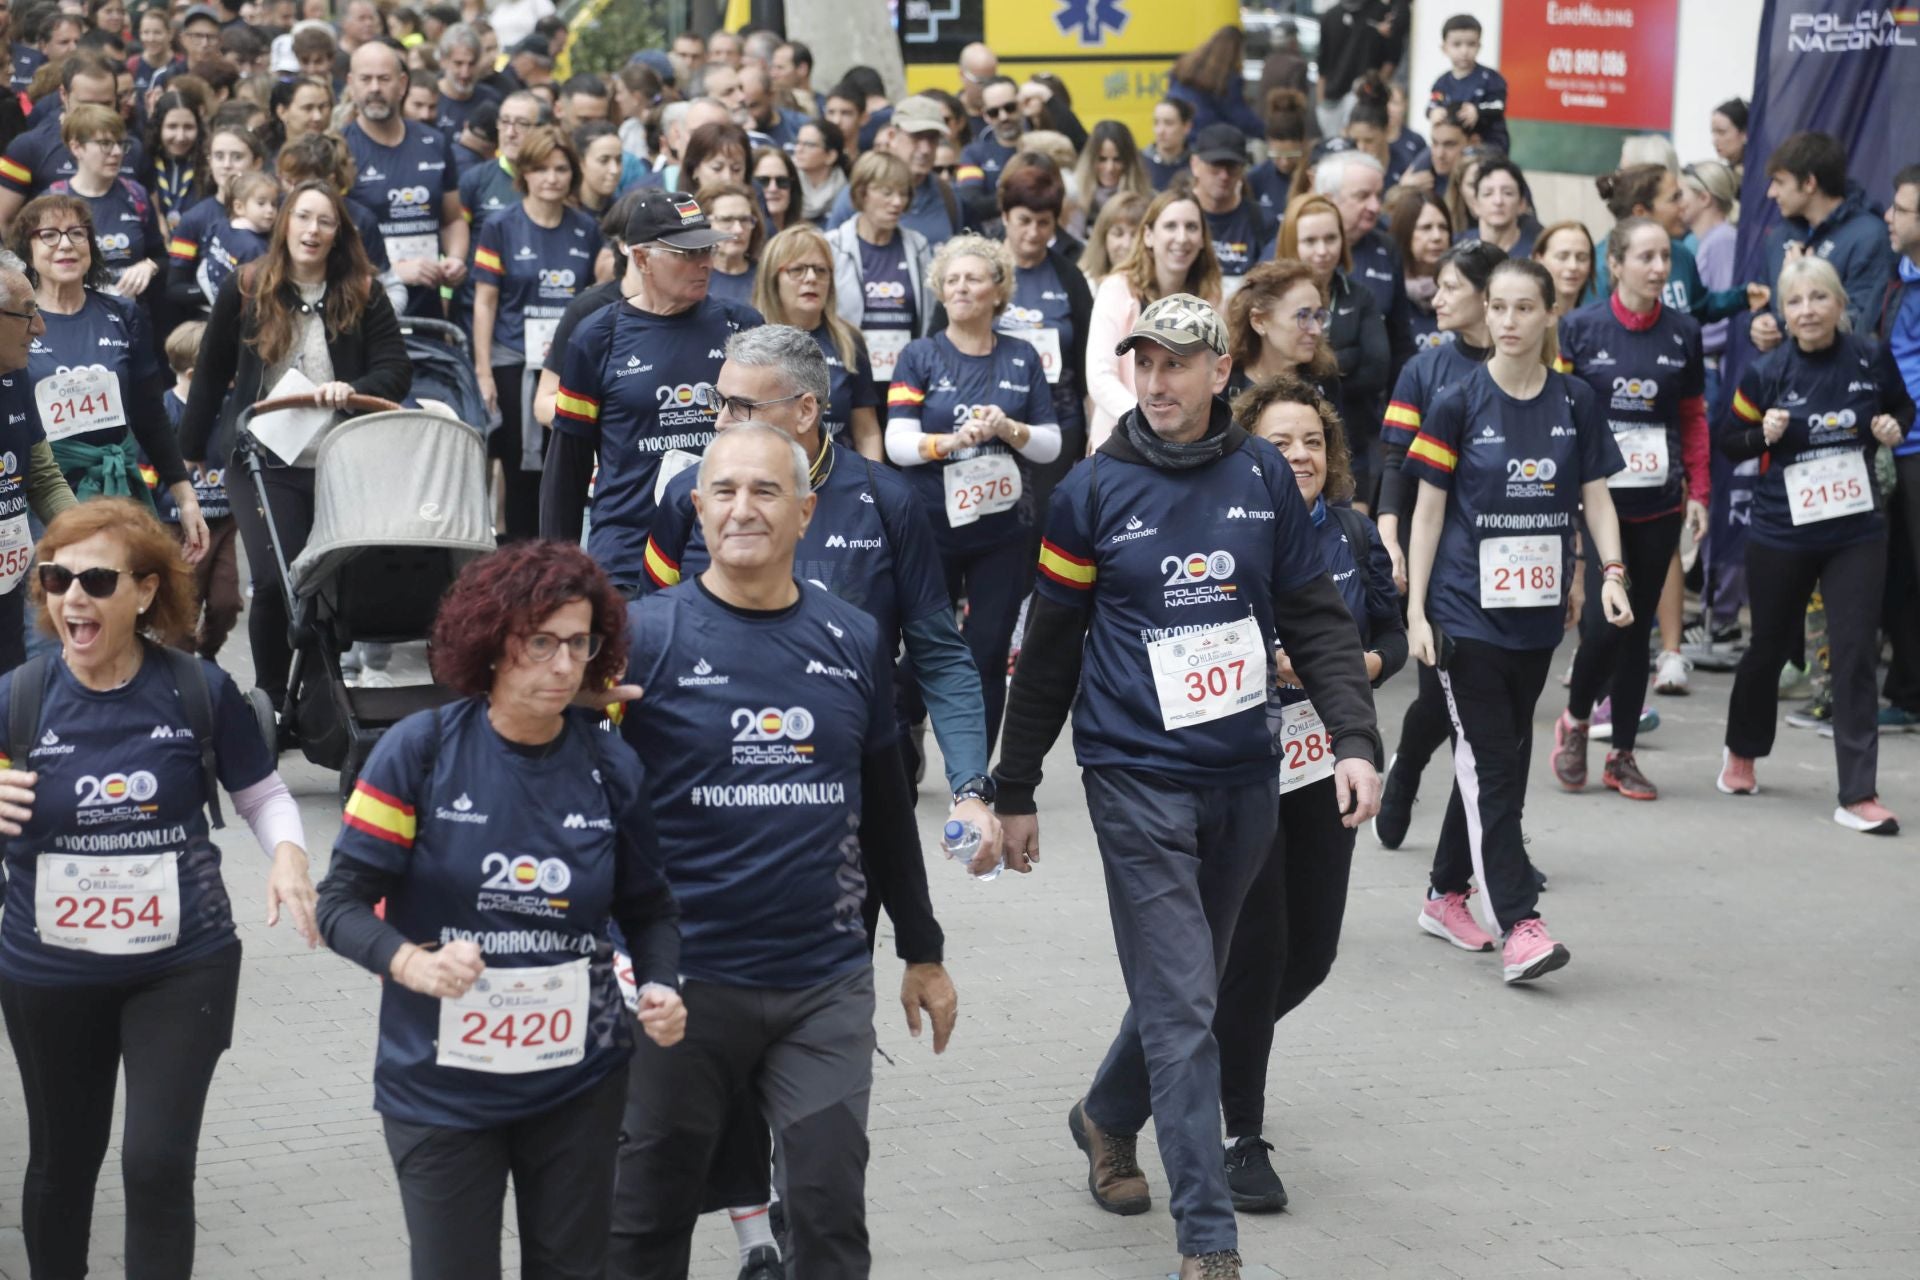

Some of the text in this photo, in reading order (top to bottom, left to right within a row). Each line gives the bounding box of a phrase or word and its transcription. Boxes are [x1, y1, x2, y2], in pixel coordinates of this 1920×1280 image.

[387, 185, 430, 207] 200
[538, 268, 576, 288] 200
[865, 281, 905, 298] 200
[616, 364, 653, 378] Santander
[655, 381, 714, 411] 200
[1612, 376, 1659, 400] 200
[50, 391, 109, 424] 2141
[658, 409, 705, 419] POLICIA
[659, 416, 717, 427] NACIONAL
[1808, 408, 1857, 434] 200
[1506, 458, 1557, 482] 200
[955, 476, 1013, 511] 2376
[1506, 483, 1545, 492] POLICIA
[1506, 490, 1555, 498] NACIONAL
[1800, 478, 1862, 508] 2155
[1475, 512, 1569, 530] #YOCORROCONLUCA
[849, 536, 882, 551] mupol
[1112, 527, 1158, 544] Santander
[1161, 550, 1236, 587] 200
[1494, 566, 1555, 591] 2183
[1163, 585, 1222, 599] POLICIA
[1165, 593, 1238, 608] NACIONAL
[678, 675, 730, 687] Santander
[1184, 659, 1245, 702] 307
[730, 706, 815, 742] 200
[732, 745, 798, 755] POLICIA
[732, 755, 814, 765] NACIONAL
[75, 770, 158, 808] 200
[691, 782, 845, 807] #YOCORROCONLUCA
[76, 804, 142, 819] POLICIA
[77, 813, 158, 826] NACIONAL
[435, 807, 488, 824] Santander
[55, 825, 187, 851] #YOCORROCONLUCA
[481, 852, 572, 894] 200
[478, 892, 551, 907] POLICIA
[55, 895, 164, 929] 2254
[477, 901, 566, 919] NACIONAL
[461, 1007, 572, 1049] 2420
